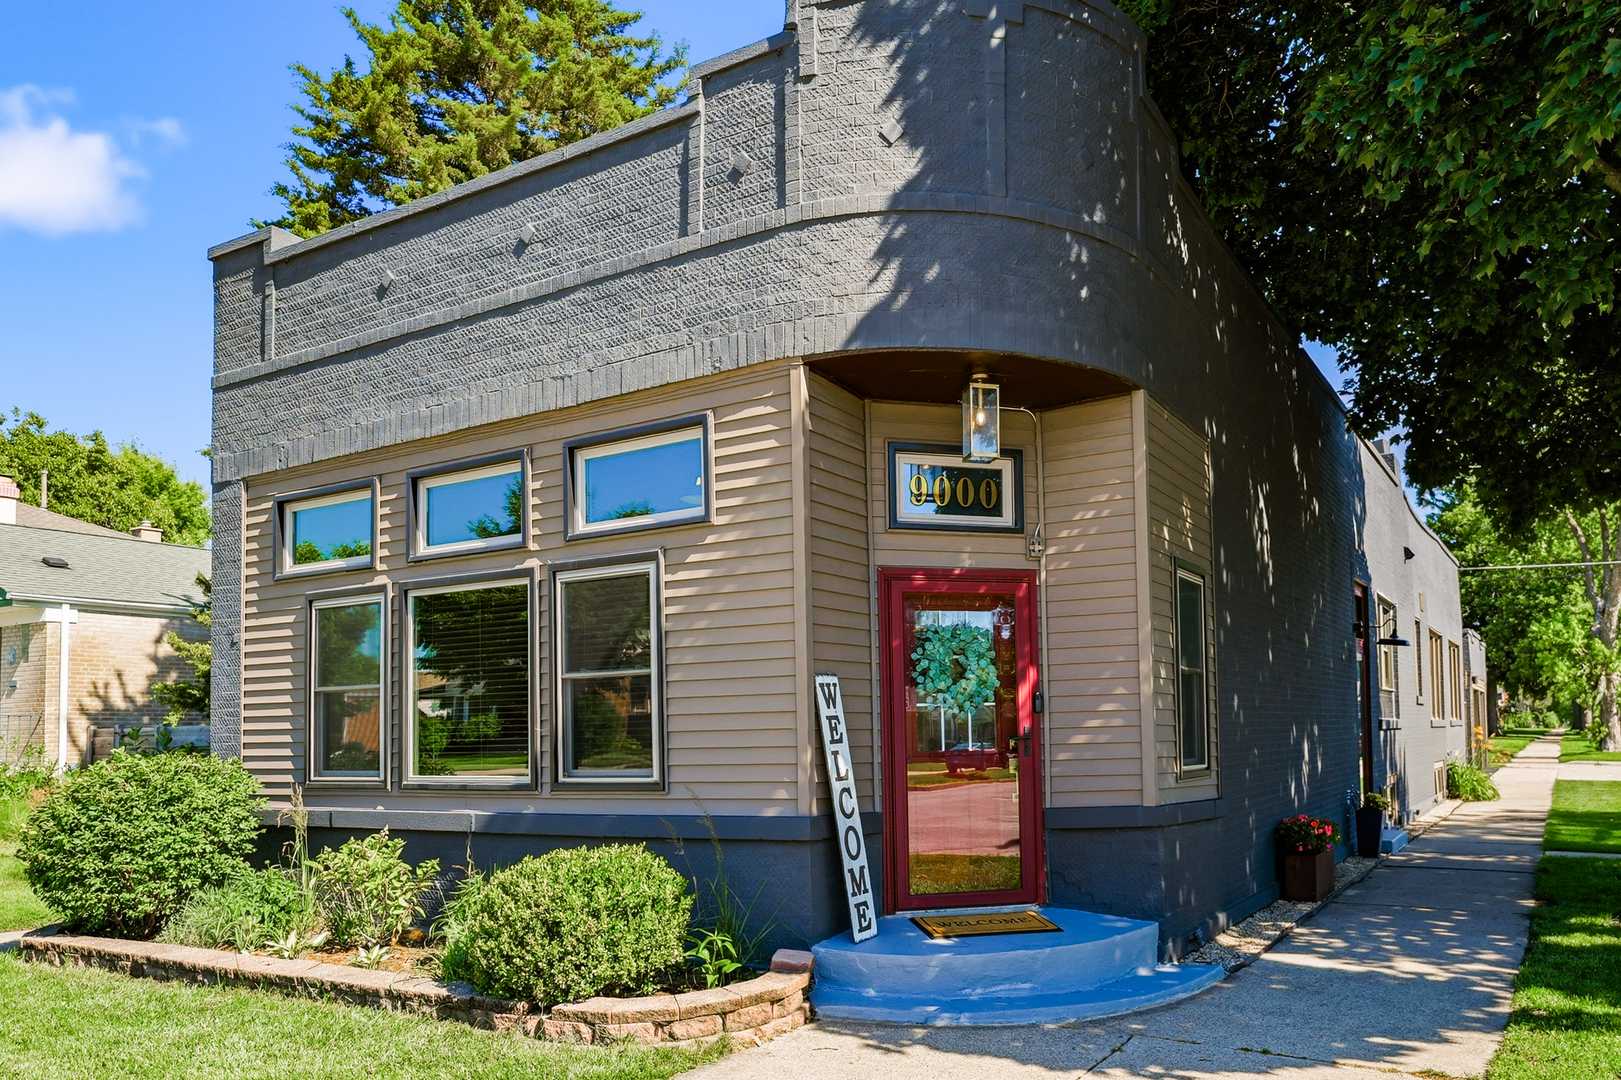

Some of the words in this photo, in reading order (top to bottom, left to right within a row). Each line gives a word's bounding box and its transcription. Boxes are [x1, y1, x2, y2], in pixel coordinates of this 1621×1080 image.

[910, 474, 998, 509] 9000
[818, 682, 872, 934] WELCOME
[935, 916, 1033, 929] WELCOME
